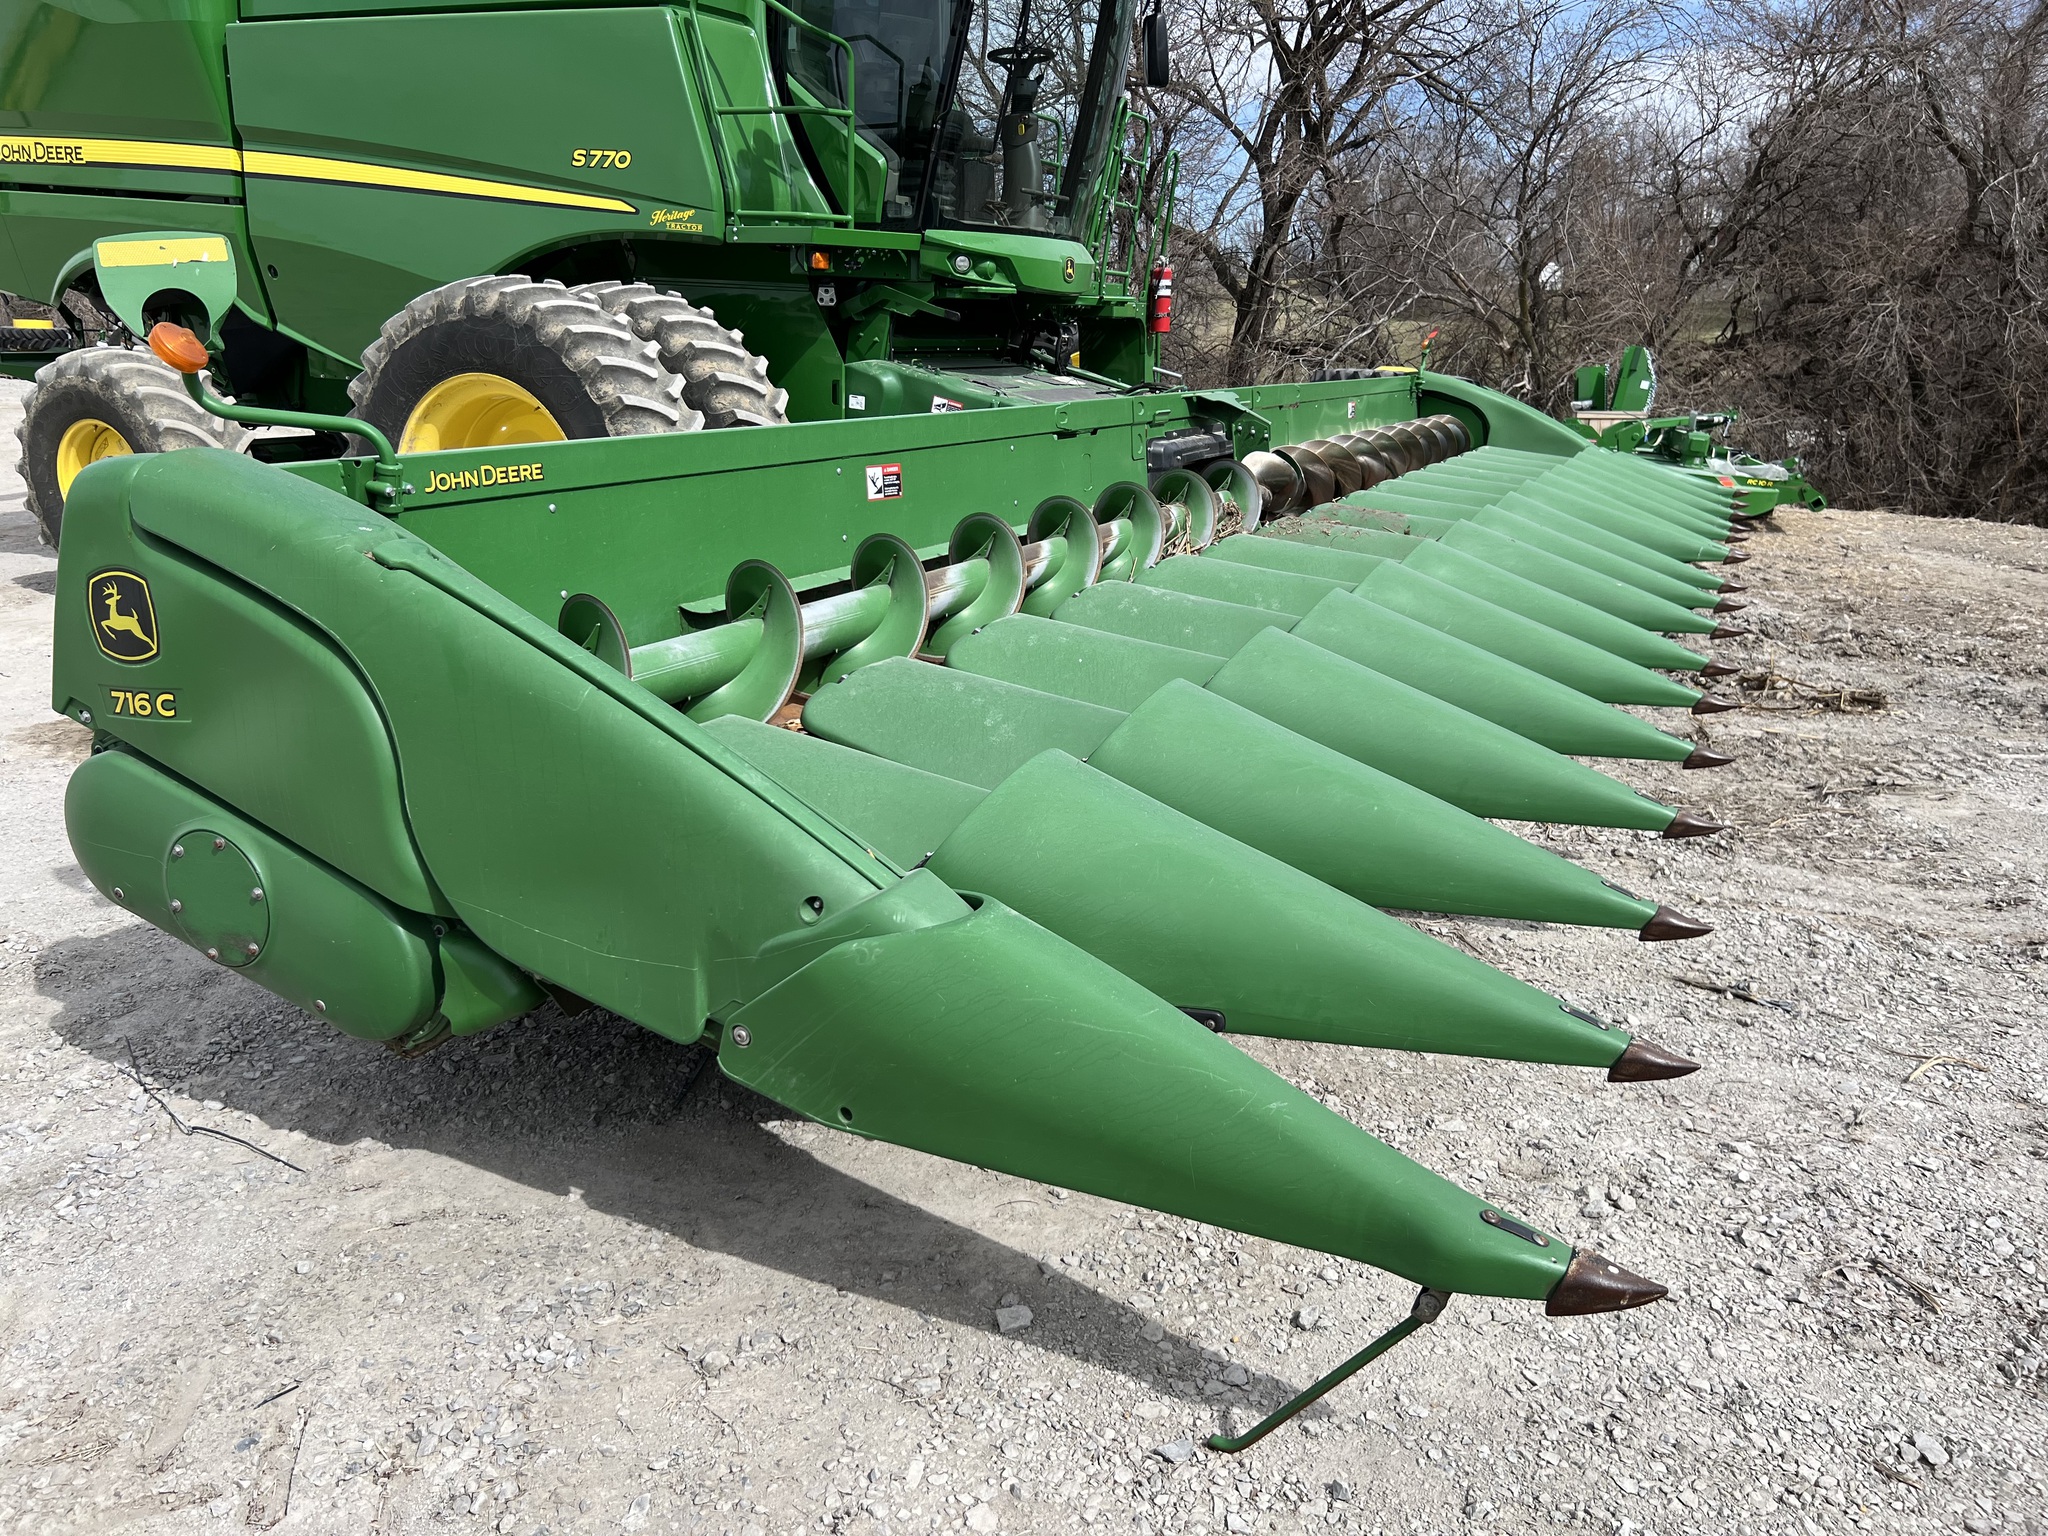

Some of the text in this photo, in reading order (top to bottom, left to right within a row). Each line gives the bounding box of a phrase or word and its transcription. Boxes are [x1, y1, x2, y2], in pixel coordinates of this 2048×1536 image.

[0, 142, 85, 161] OHN DEERE
[571, 148, 633, 170] S770
[649, 208, 696, 226] Heritage
[665, 221, 703, 232] TRACTOR
[424, 463, 544, 493] JOHN DEERE
[110, 689, 177, 719] 716 C
